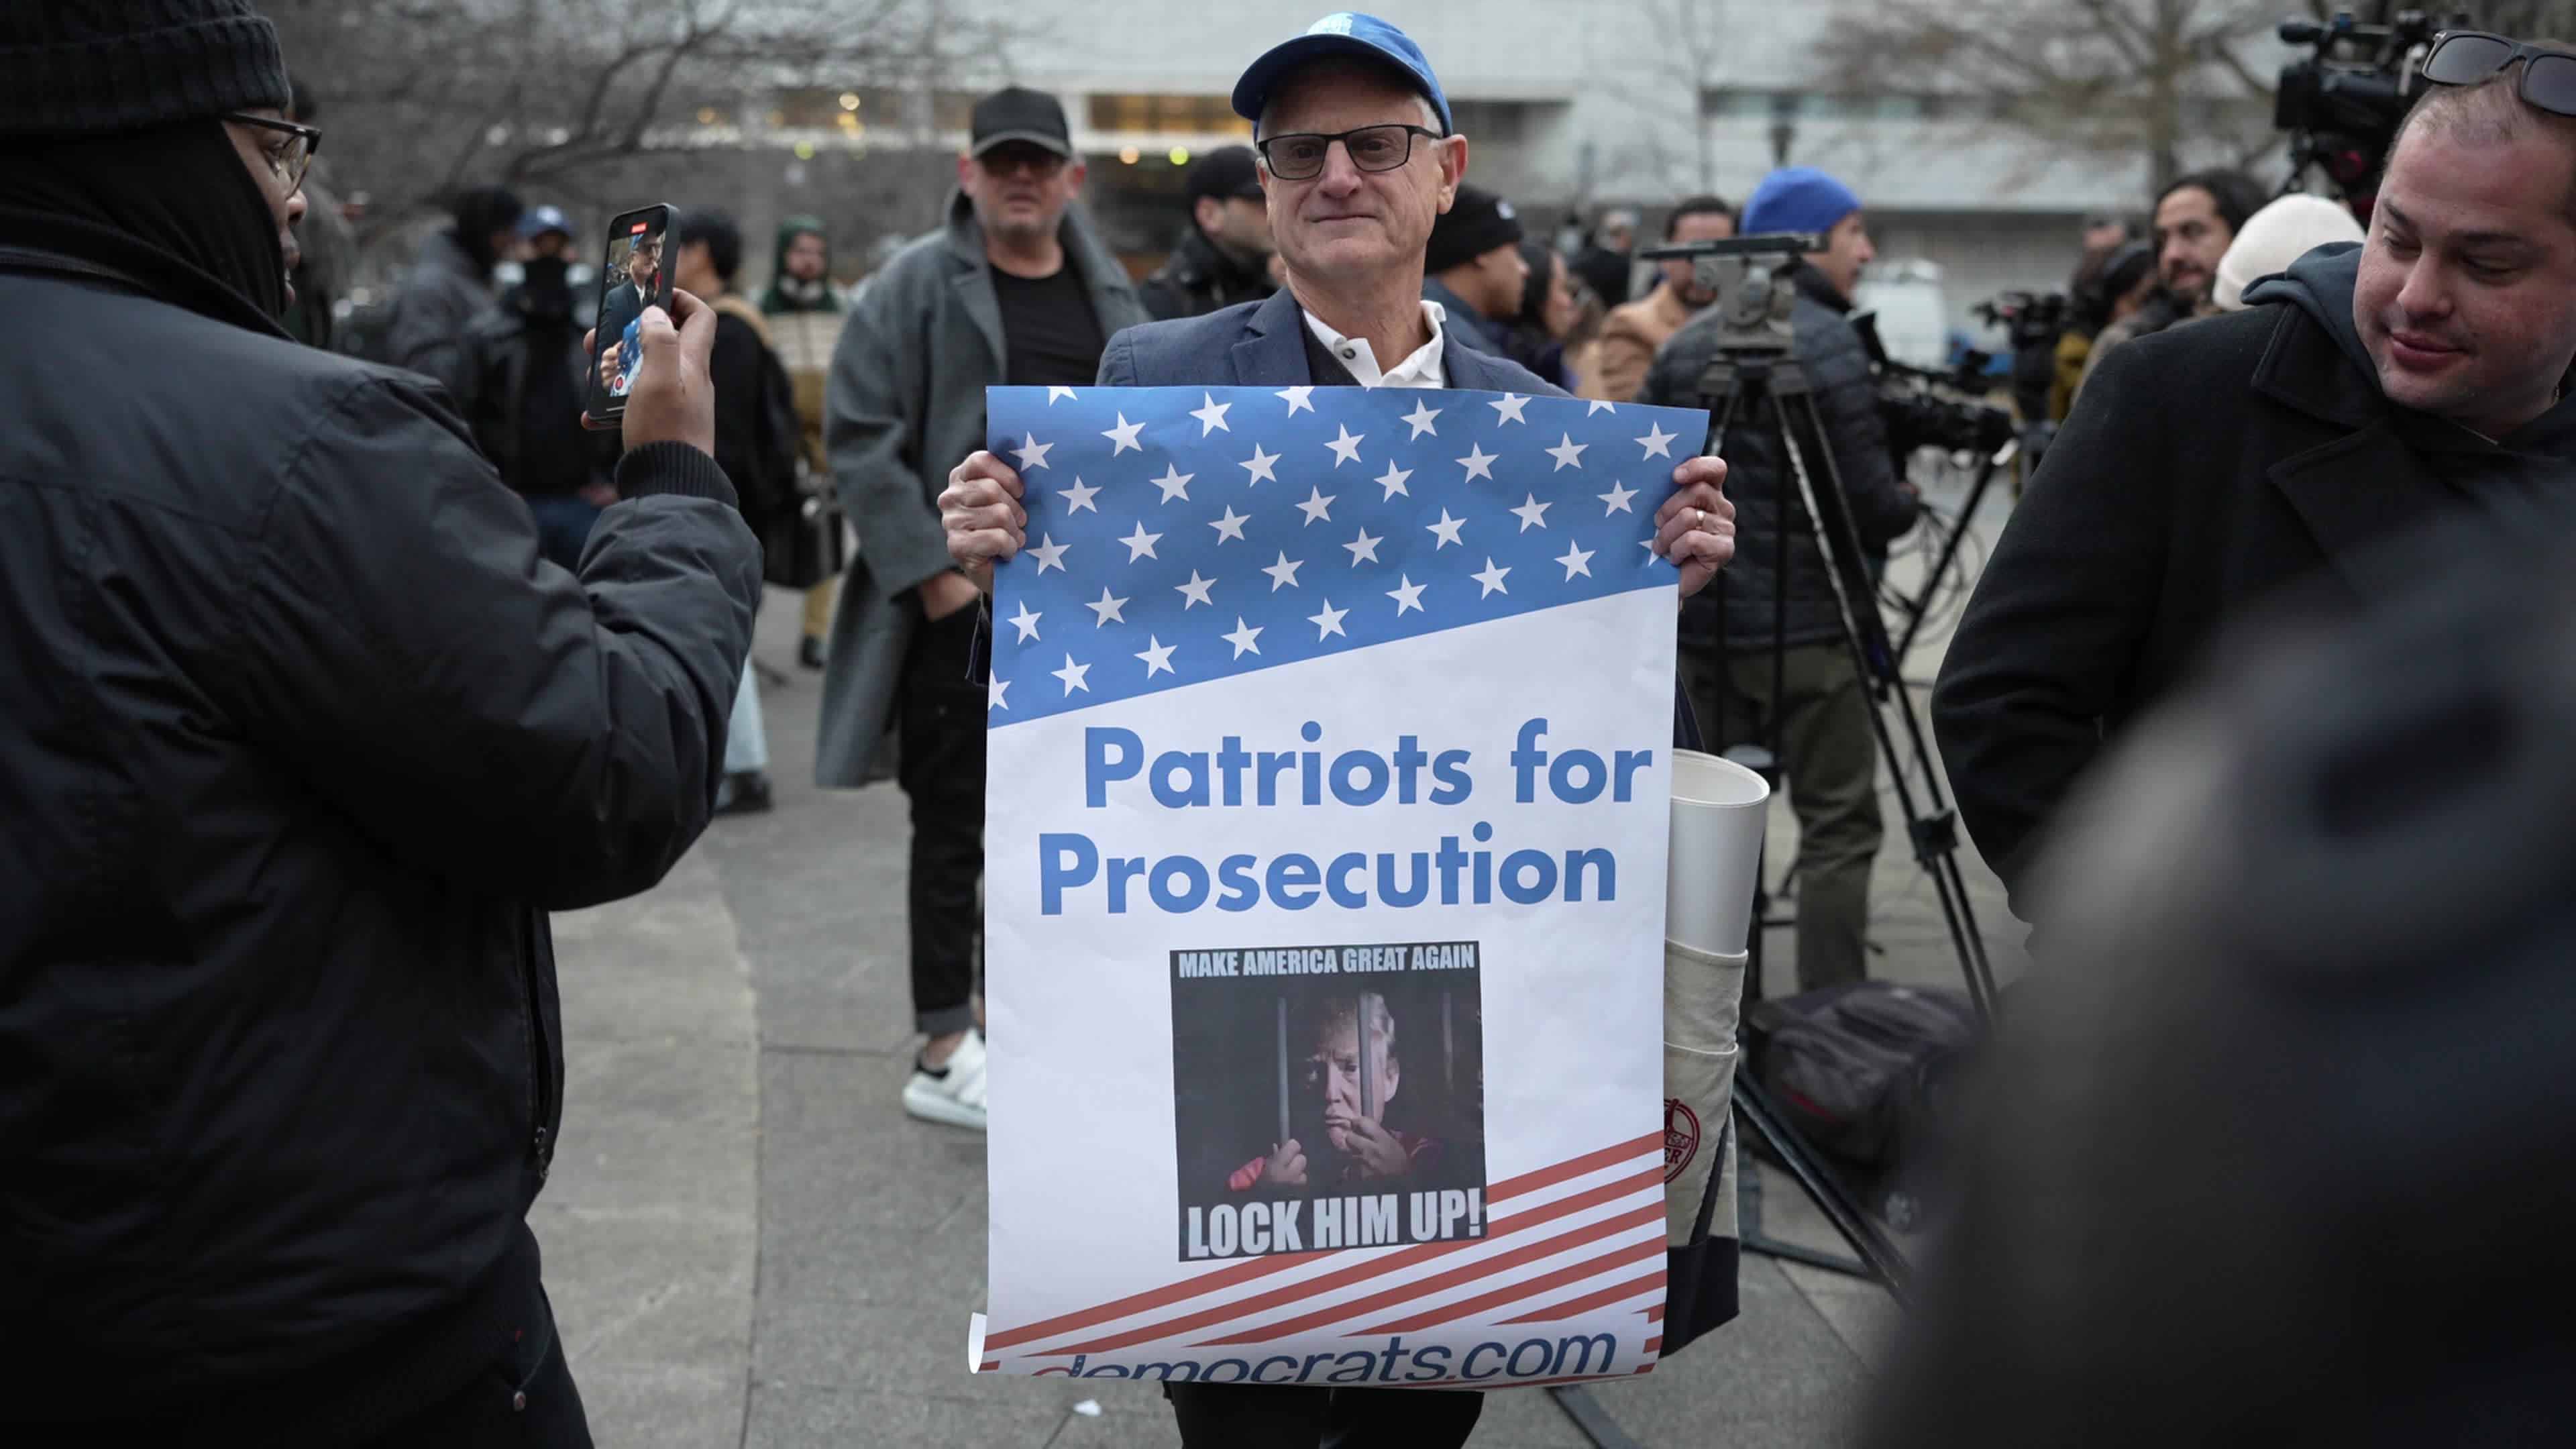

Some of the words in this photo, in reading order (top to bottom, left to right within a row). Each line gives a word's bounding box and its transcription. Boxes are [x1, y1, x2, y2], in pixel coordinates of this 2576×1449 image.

[1085, 721, 1472, 808] Patriots
[1510, 718, 1653, 804] for
[1039, 821, 1616, 915] Prosecution
[1179, 951, 1239, 977] MAKE
[1242, 949, 1339, 976] AMERICA
[1342, 947, 1408, 973] GREAT
[1411, 944, 1474, 970] AGAIN
[1188, 1200, 1303, 1258] LOCK
[1313, 1193, 1399, 1250] HIM
[1409, 1187, 1481, 1242] UP!
